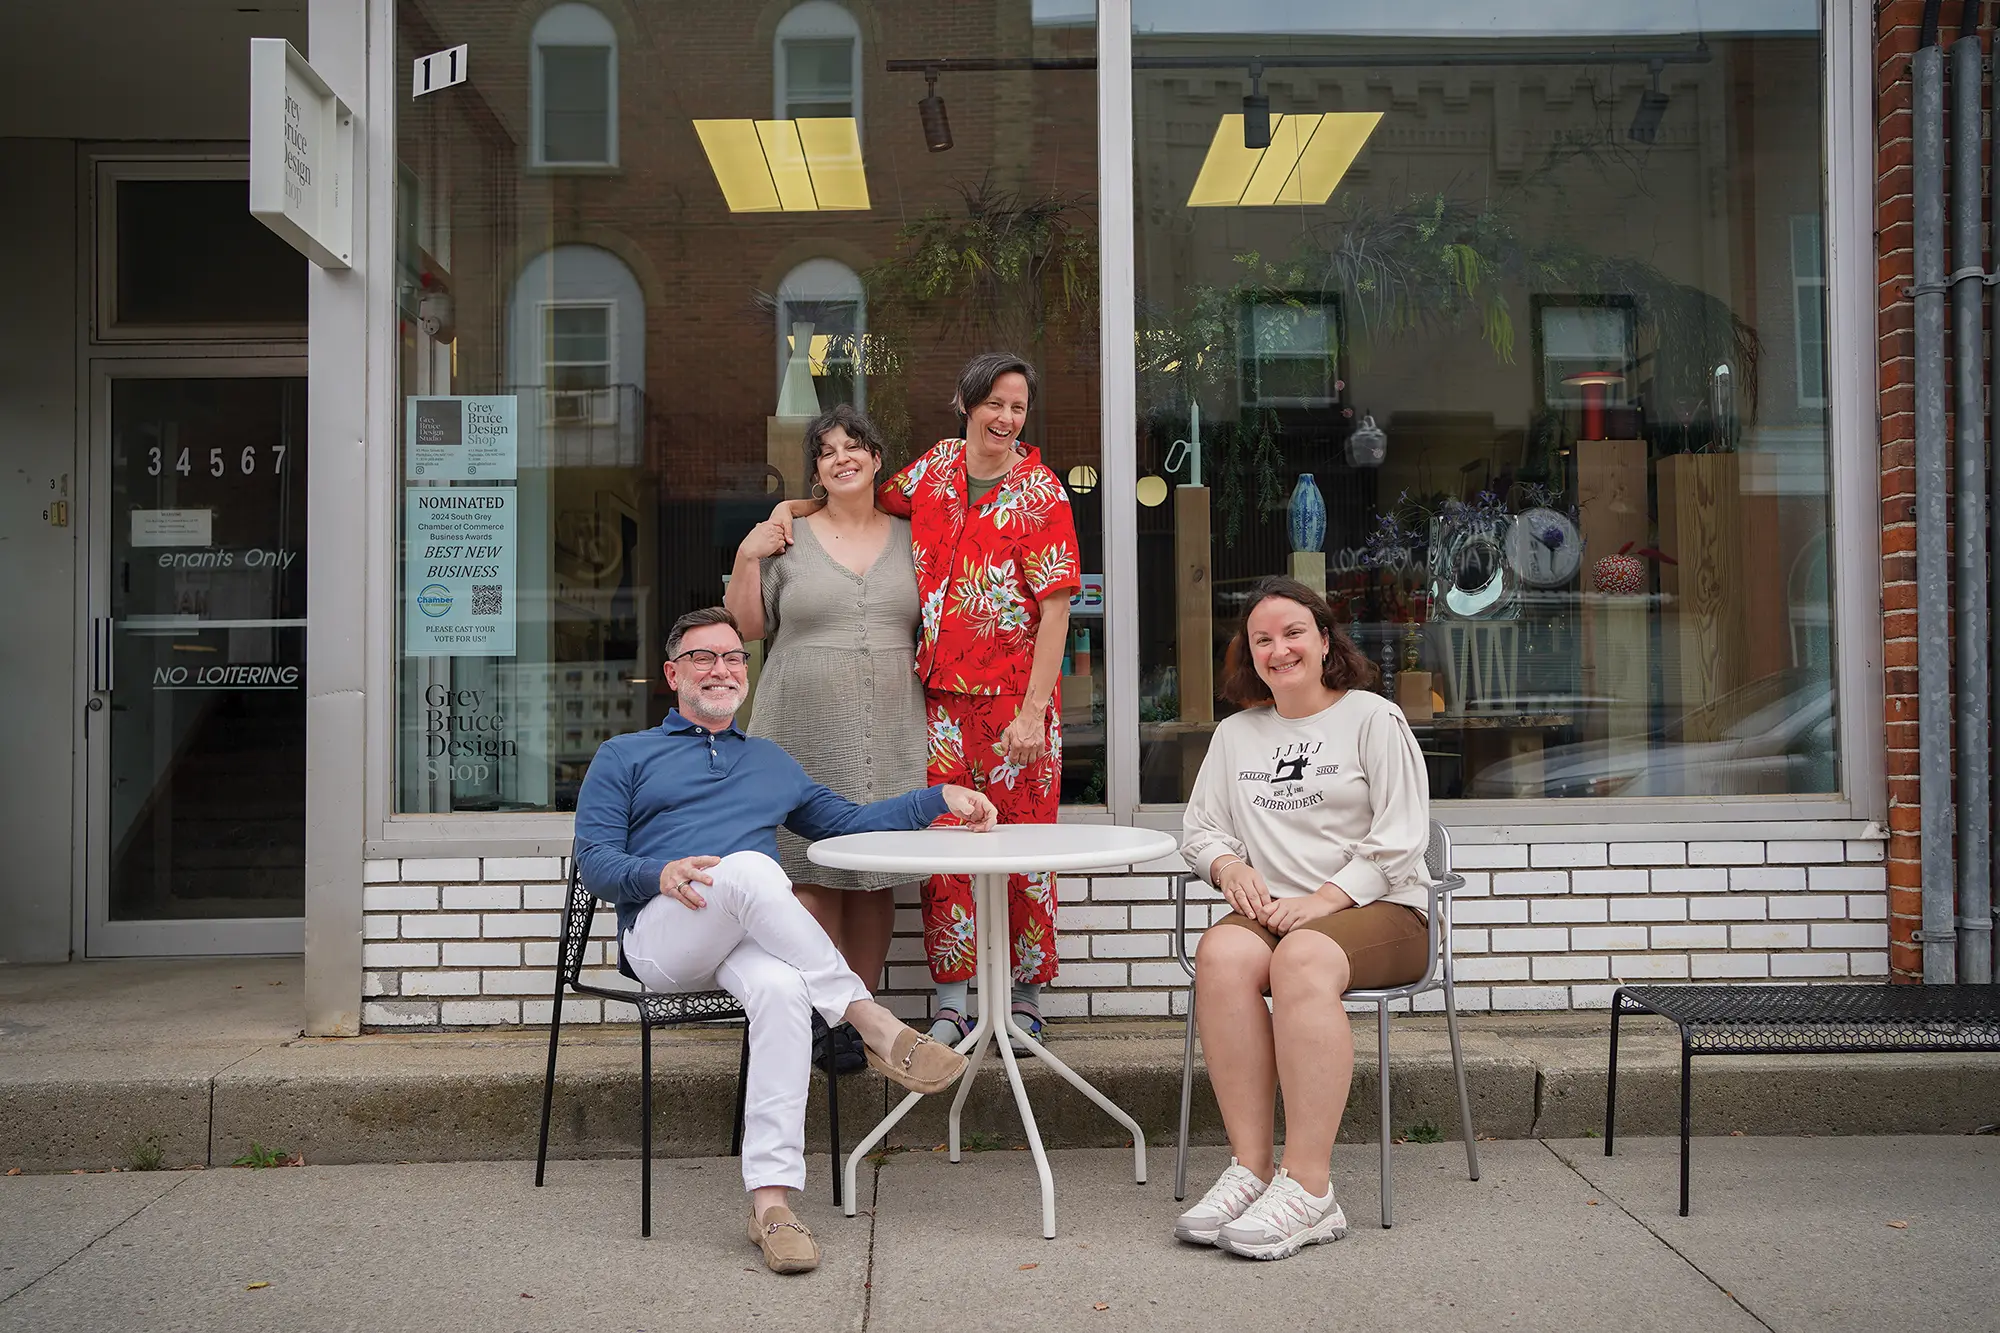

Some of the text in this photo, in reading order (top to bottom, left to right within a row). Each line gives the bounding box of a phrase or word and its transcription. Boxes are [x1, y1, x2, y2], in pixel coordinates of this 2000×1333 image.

[422, 50, 457, 91] 11
[285, 172, 302, 209] hop
[468, 402, 494, 413] Grey
[420, 416, 435, 424] Grey
[468, 413, 503, 424] Bruce
[468, 424, 508, 436] Design
[468, 435, 496, 446] Shop
[148, 446, 286, 477] 3 4 5 6 7
[50, 478, 56, 489] 3
[418, 496, 504, 508] NOMINATED
[42, 510, 48, 520] 6
[244, 548, 296, 570] Only
[424, 546, 503, 558] BEST NEW
[426, 566, 500, 578] BUSINESS
[152, 666, 298, 684] NO LOITERING
[425, 684, 486, 714] Grey
[426, 710, 504, 732] Bruce
[426, 734, 518, 762] Design
[1239, 766, 1339, 782] TAILOR SHOP
[1252, 791, 1324, 811] EMBROIDERY
